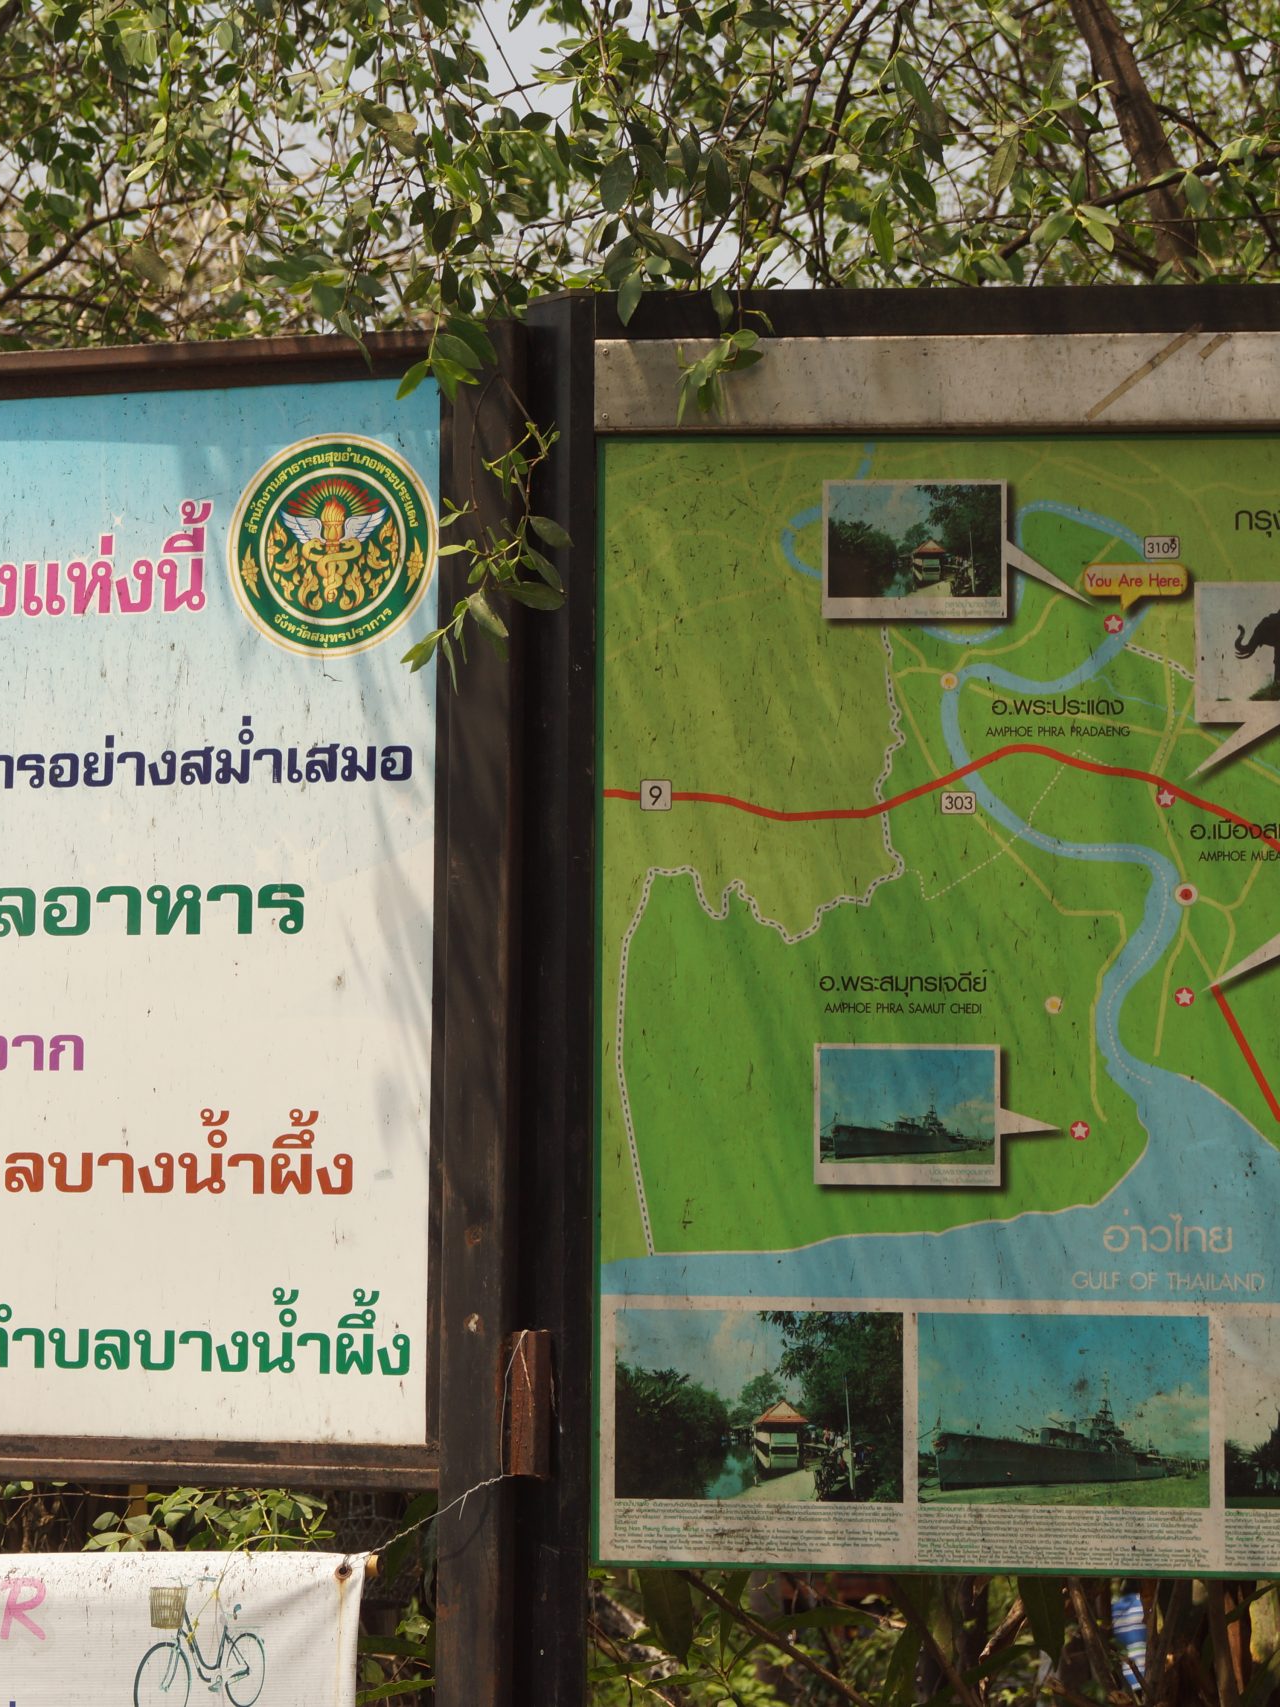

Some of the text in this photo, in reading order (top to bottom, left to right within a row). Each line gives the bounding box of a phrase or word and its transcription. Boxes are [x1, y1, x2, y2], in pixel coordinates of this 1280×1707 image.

[1147, 542, 1177, 554] 3109
[1086, 572, 1184, 588] You Are Here.
[991, 695, 1125, 716] อ.พระประแดง
[986, 726, 1130, 737] AMPHOE PHRA PRADAENG
[649, 785, 663, 806] 9
[945, 795, 973, 810] 303
[1190, 818, 1280, 840] อ.เมืองส
[1199, 850, 1246, 861] AMPHOE
[819, 969, 988, 997] อ.พระสมุทรเจดีย์
[824, 1002, 982, 1015] AMPHOE PHRA SAMUT CHEDI
[1103, 1208, 1233, 1253] อ่าวไทย
[1072, 1271, 1265, 1292] GULF OF THAILAND
